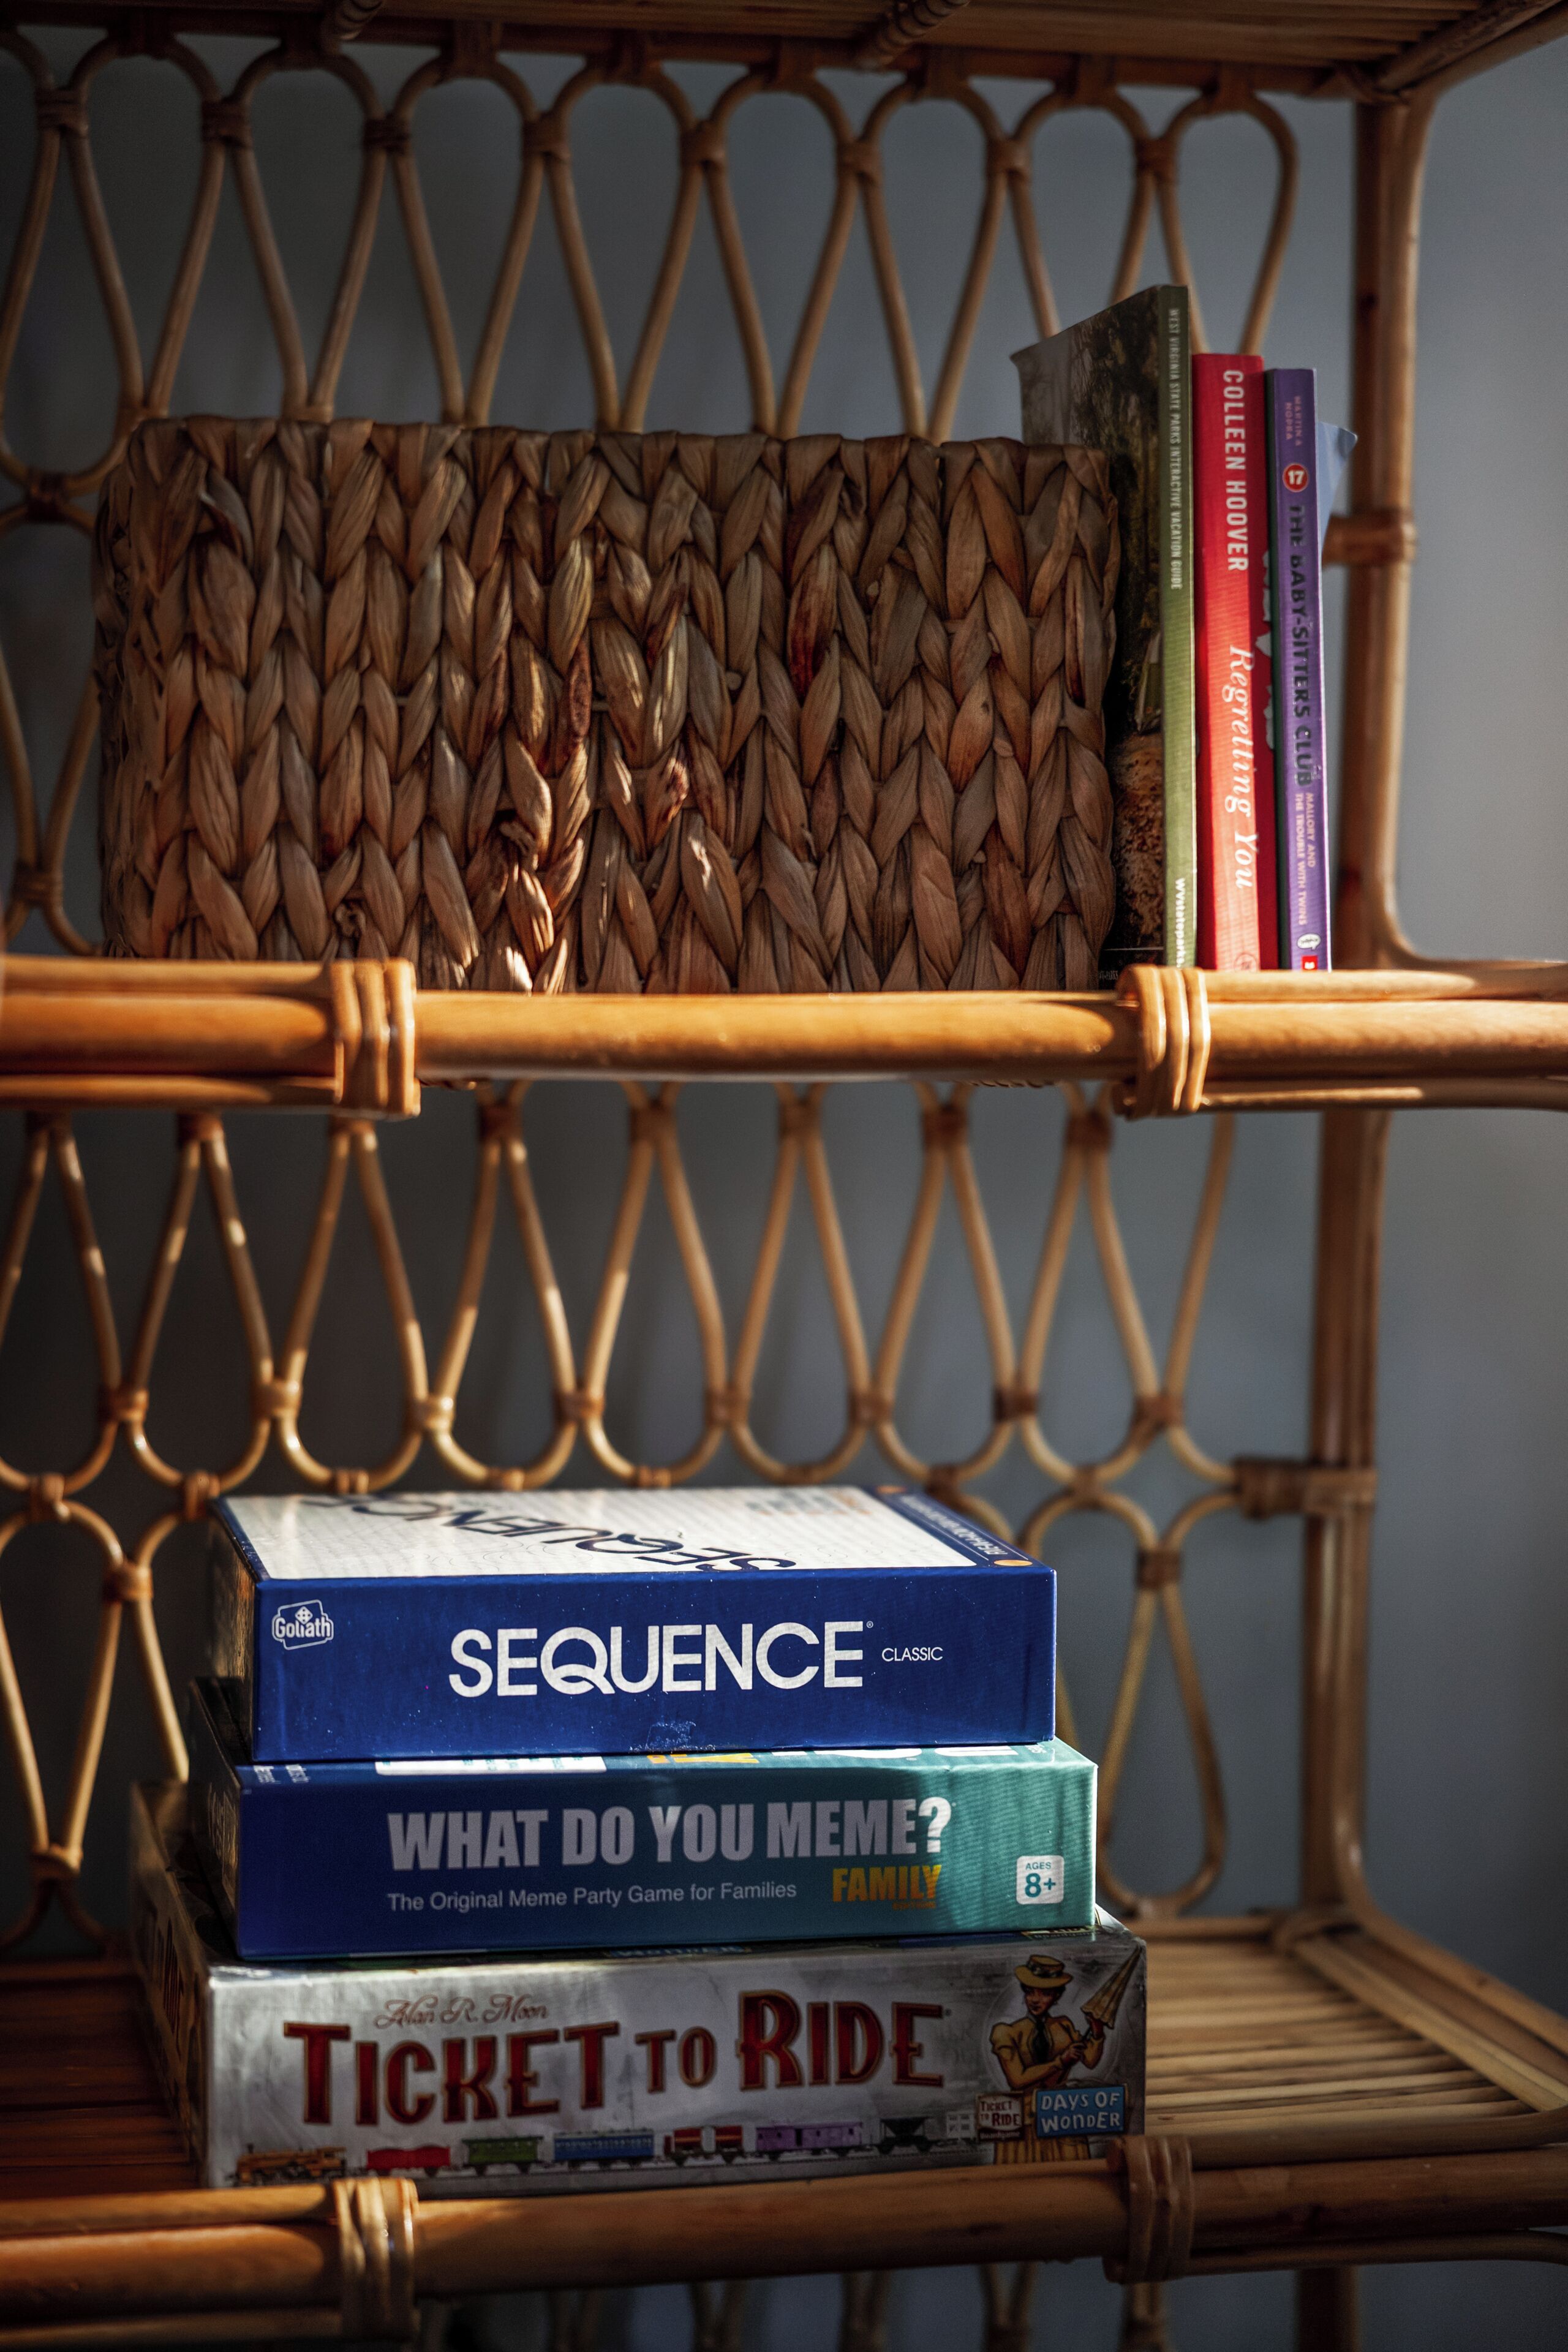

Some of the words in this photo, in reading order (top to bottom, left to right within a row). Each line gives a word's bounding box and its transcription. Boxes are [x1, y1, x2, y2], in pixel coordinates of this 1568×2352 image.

[1169, 336, 1181, 380] VIRGINIA
[1169, 382, 1182, 410] STATE
[1170, 413, 1182, 444] PARKS
[1223, 369, 1246, 470] COLLEEN
[1169, 446, 1182, 509] INTERACTIVE
[1287, 470, 1305, 485] 17
[1170, 511, 1182, 558] VACATION
[1226, 480, 1250, 571] HOOVER
[1289, 505, 1305, 547] THE
[1170, 560, 1183, 590] GUIDE
[1290, 554, 1310, 719] BABY-SITTERS
[1222, 644, 1256, 818] Regretting
[1295, 724, 1313, 787] CLUB
[1295, 793, 1305, 812] THE
[1305, 792, 1316, 842] MALLORY
[1296, 814, 1306, 858] TROUBLE
[1234, 831, 1259, 890] You
[1297, 861, 1306, 888] WITH
[1307, 844, 1316, 868] AND
[1298, 891, 1308, 926] TWINS
[275, 1615, 332, 1638] Goliath
[448, 1620, 864, 1698] SEQUENCE
[881, 1646, 944, 1662] CLASSIC
[387, 1809, 549, 1871] WHAT
[561, 1805, 635, 1866] DO
[648, 1803, 755, 1863] YOU
[766, 1796, 952, 1859] MEME?
[832, 1864, 943, 1903] FAMILY
[1024, 1872, 1056, 1898] 8+
[1025, 1861, 1052, 1871] AGES
[387, 1893, 424, 1912] The
[430, 1890, 503, 1914] Original
[509, 1888, 568, 1907] Meme
[573, 1887, 623, 1906] Party
[628, 1885, 685, 1905] Game
[690, 1883, 715, 1900] for
[720, 1880, 797, 1901] Families
[481, 1992, 549, 2024] Moon
[282, 2021, 620, 2127] TICKET
[635, 2026, 717, 2095] TO
[736, 1989, 945, 2091] RIDE
[991, 2112, 1021, 2127] RIDE
[1041, 2092, 1089, 2112] DAYS
[1094, 2090, 1120, 2108] OF
